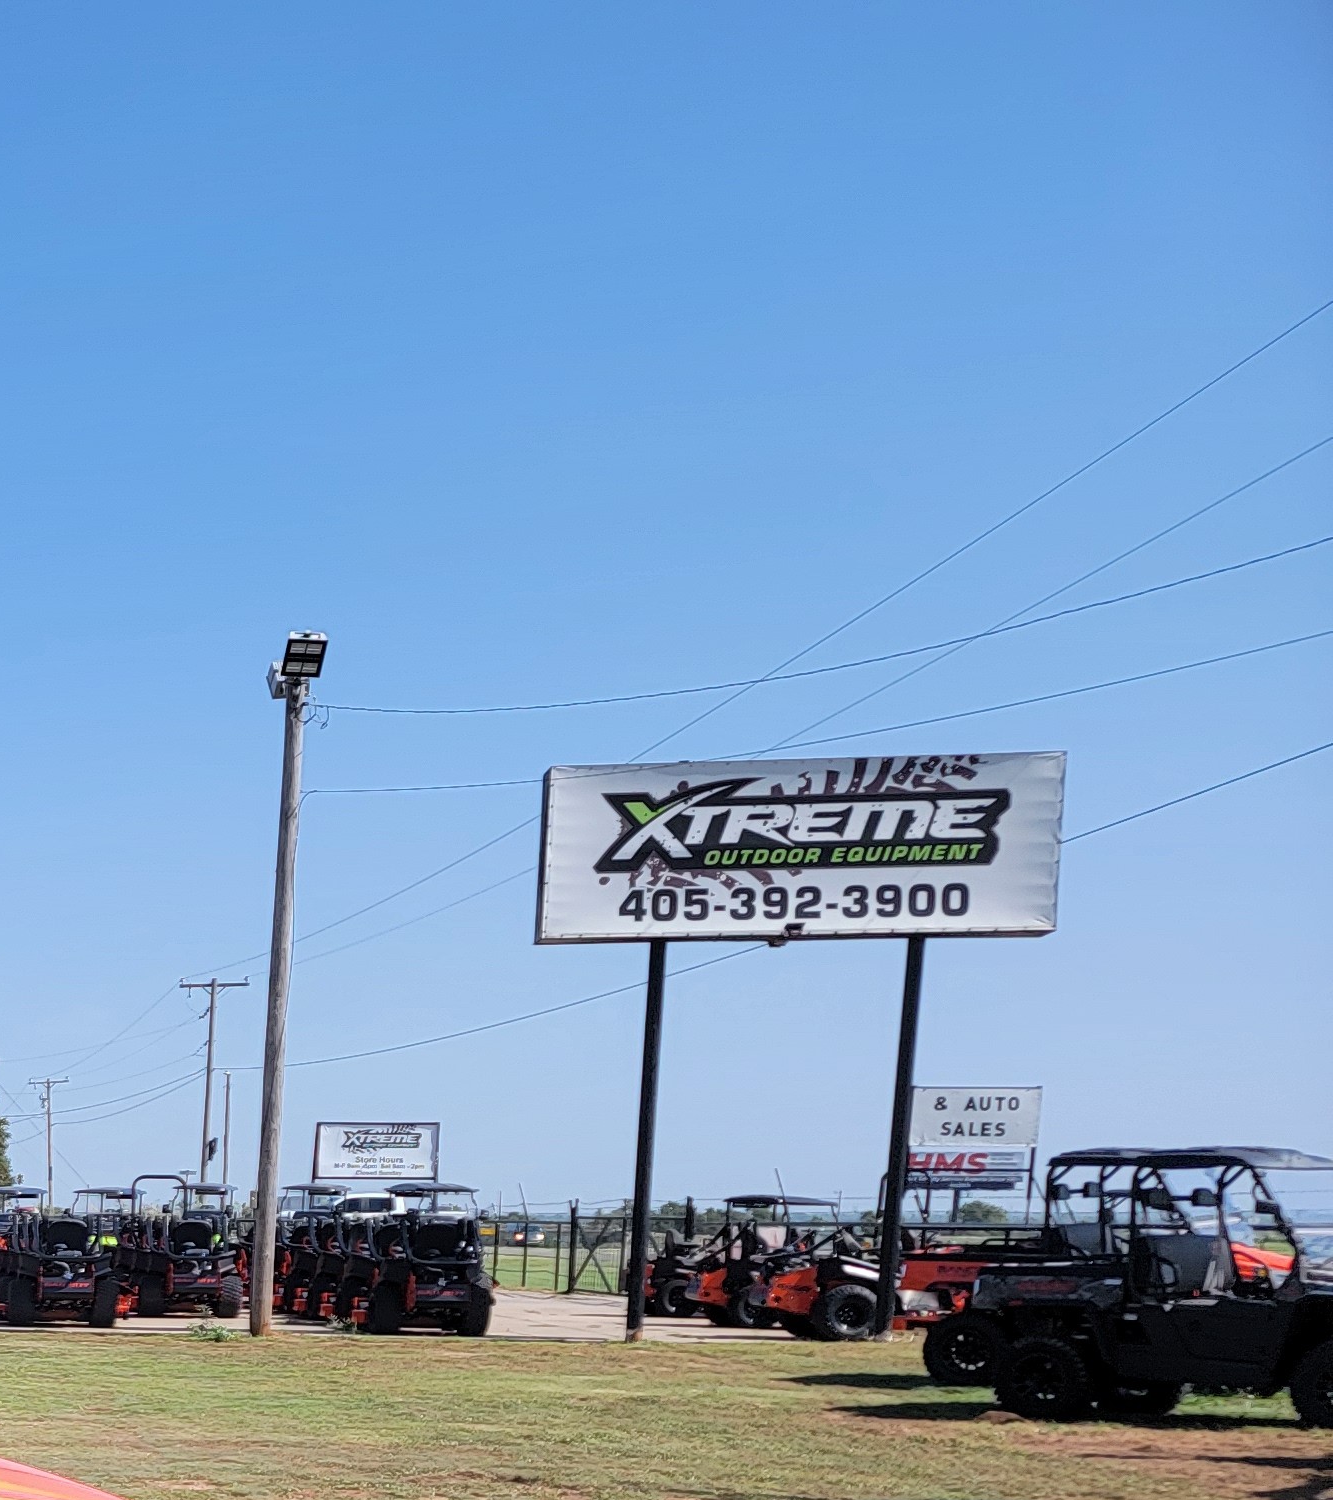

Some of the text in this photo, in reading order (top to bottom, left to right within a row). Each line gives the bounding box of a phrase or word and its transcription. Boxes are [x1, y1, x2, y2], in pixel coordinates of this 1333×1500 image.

[607, 778, 999, 861] XTREME
[703, 843, 984, 866] OUTDOOR EQUIPMENT
[619, 882, 970, 922] 405-392-3900
[934, 1096, 1020, 1111] & AUTO
[344, 1129, 420, 1146] XTREME
[940, 1121, 1006, 1137] SALES
